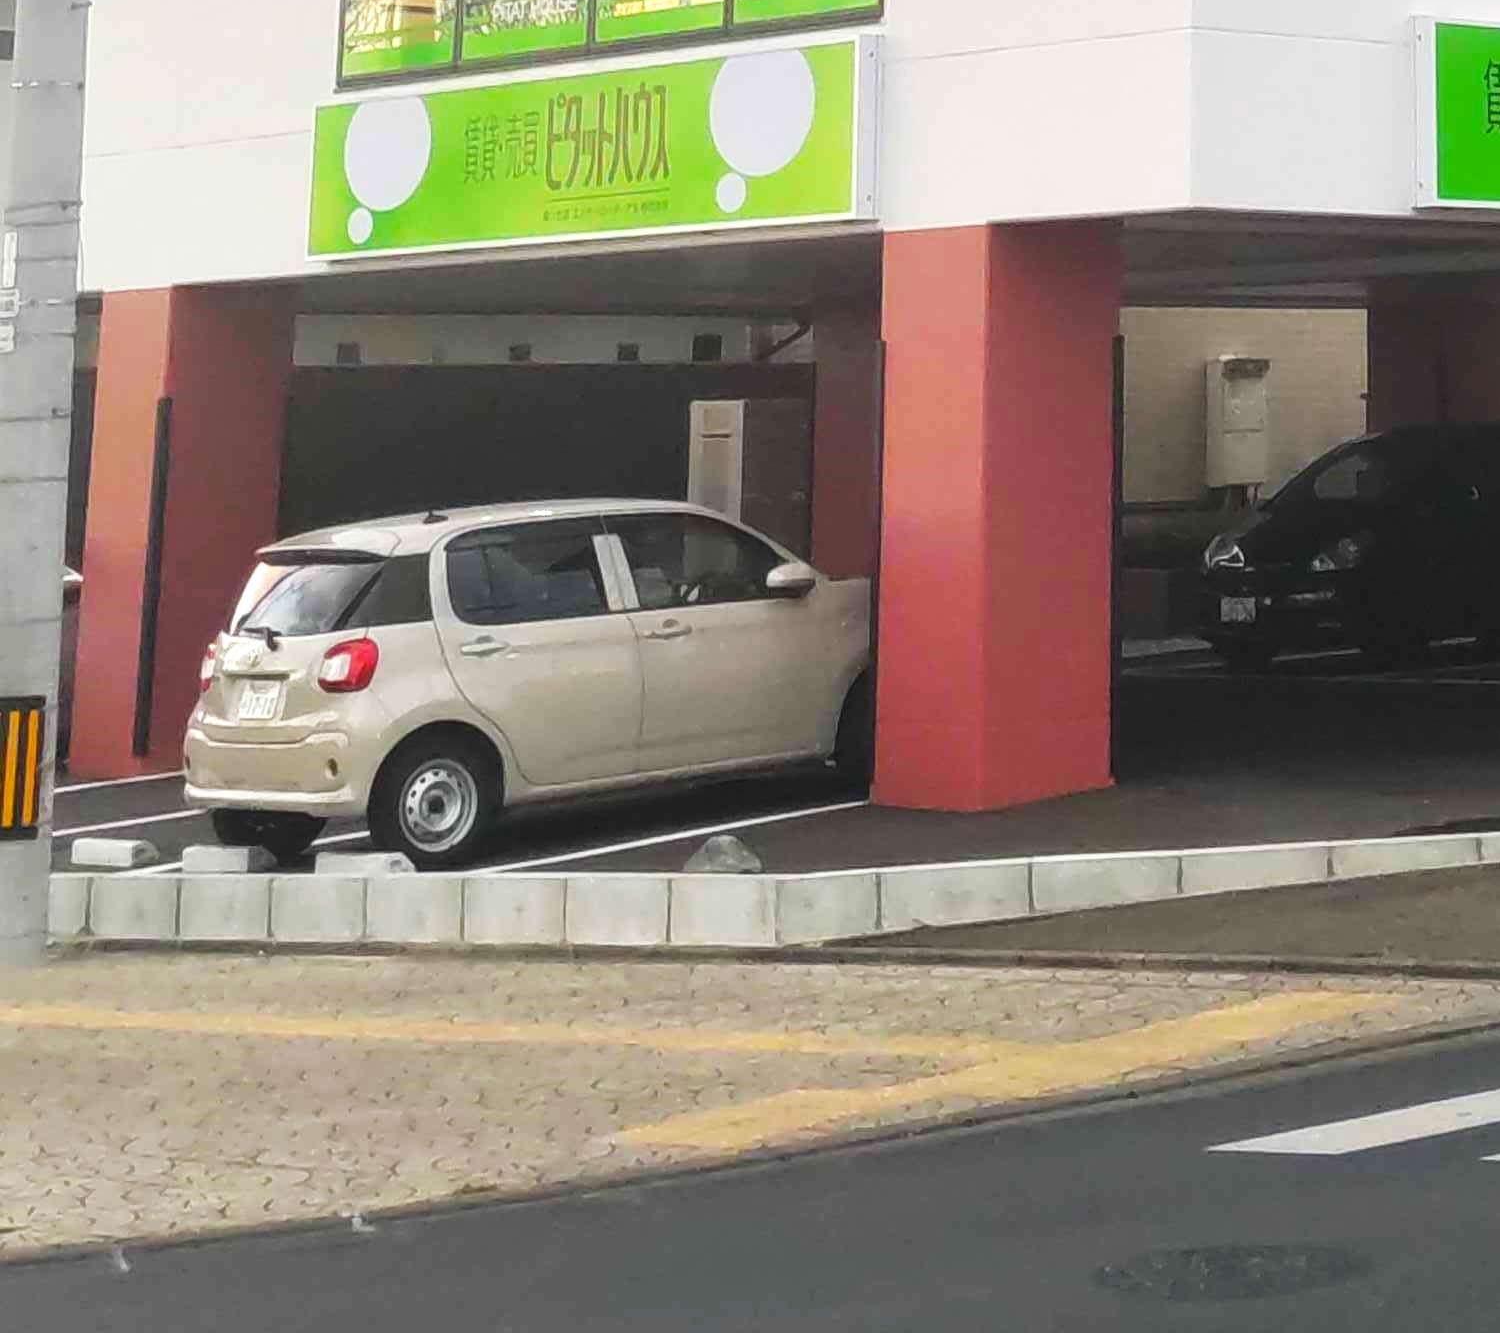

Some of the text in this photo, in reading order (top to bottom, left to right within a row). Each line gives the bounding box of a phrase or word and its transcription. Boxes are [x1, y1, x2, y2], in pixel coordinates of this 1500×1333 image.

[544, 81, 671, 191] ピタットハウス
